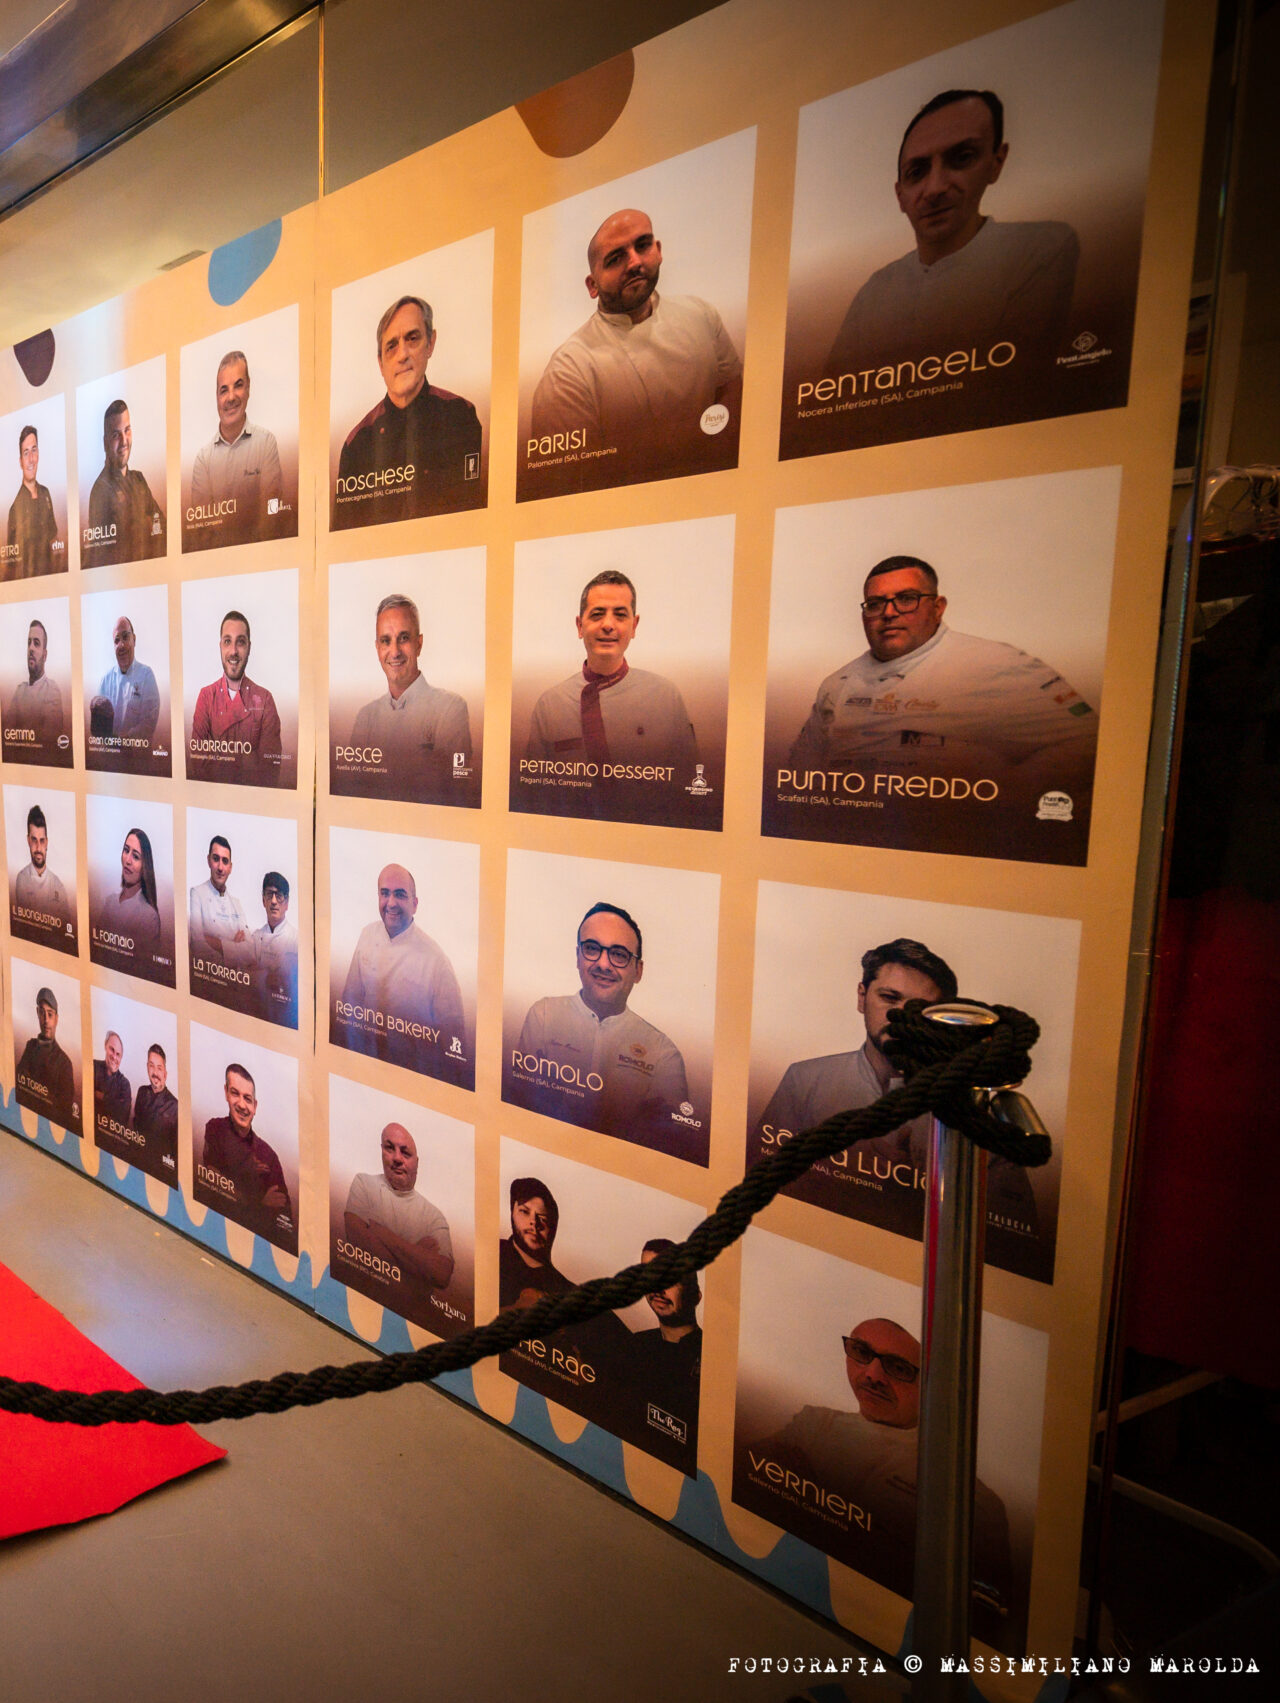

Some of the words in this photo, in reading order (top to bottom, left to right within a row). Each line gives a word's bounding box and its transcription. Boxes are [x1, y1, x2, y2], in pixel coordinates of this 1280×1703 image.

[797, 405, 834, 419] Nocera
[835, 396, 878, 413] Inferiore
[880, 392, 904, 406] (SA),
[905, 380, 964, 402] Campania
[527, 456, 564, 470] Palomonte
[564, 454, 580, 465] (SA),
[580, 447, 618, 462] Campania
[336, 492, 374, 503] Pontecagnano
[384, 485, 412, 496] Campania
[362, 765, 388, 774] Campania
[520, 776, 542, 785] Pagani
[558, 779, 592, 788] Campania
[777, 793, 809, 805] Scafati
[810, 795, 832, 806] (SA),
[832, 797, 884, 810] Campania
[618, 1054, 654, 1071] ROMOLO
[512, 1071, 535, 1083] Salerno
[551, 1082, 585, 1098] Campania
[671, 1112, 701, 1128] ROMOLO
[833, 1169, 883, 1192] Campania
[430, 1295, 467, 1322] Sorbara
[802, 1501, 849, 1532] Campania
